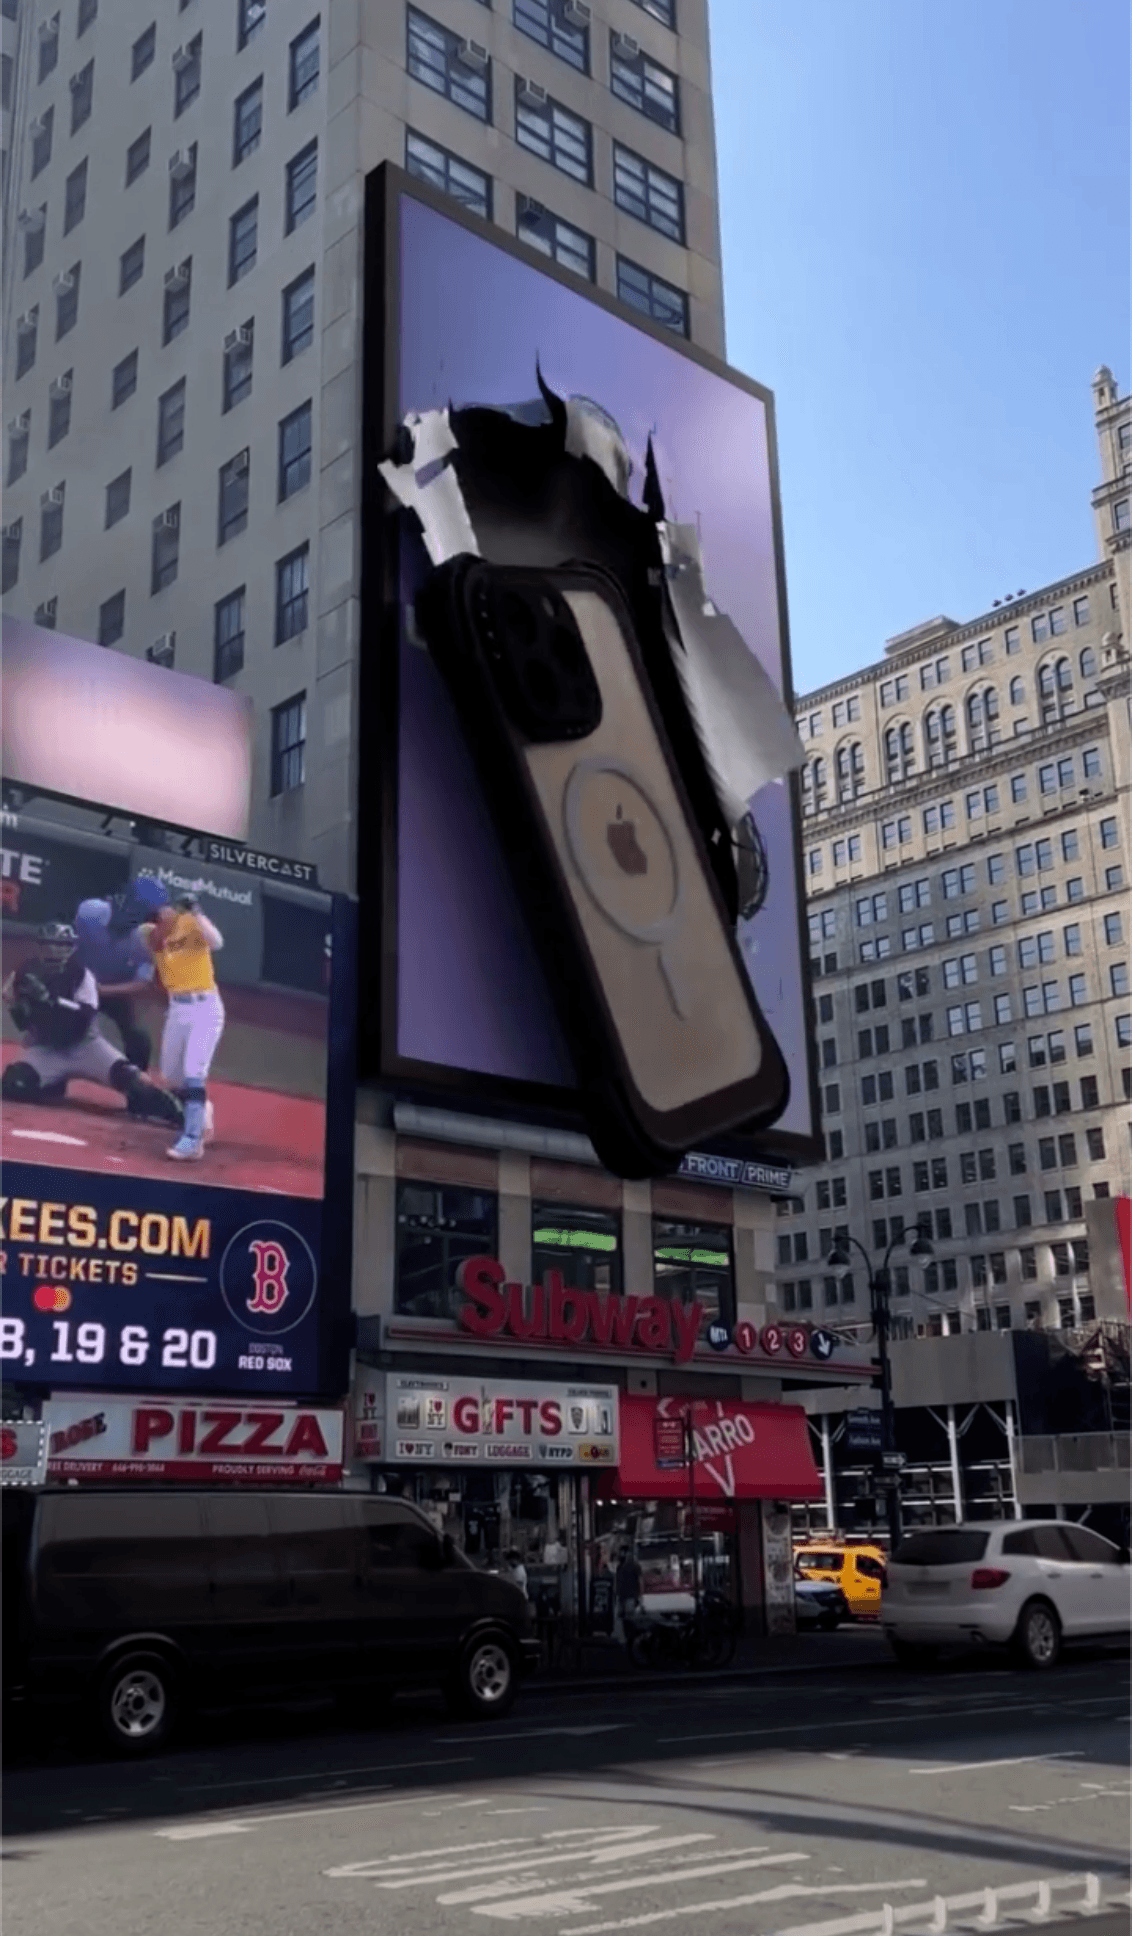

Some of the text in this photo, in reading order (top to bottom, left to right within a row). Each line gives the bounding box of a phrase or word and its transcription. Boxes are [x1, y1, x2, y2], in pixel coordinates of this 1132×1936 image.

[209, 843, 313, 880] SILVERCAST
[158, 867, 253, 905] MassMutual
[747, 1167, 788, 1186] PRIME
[1, 1199, 210, 1259] EES.COM
[18, 1252, 138, 1286] TICKETS
[456, 1256, 703, 1365] Subway
[51, 1321, 105, 1364] 19
[119, 1326, 150, 1366] &
[162, 1328, 217, 1369] 20
[742, 1327, 750, 1348] 1
[768, 1330, 780, 1350] 2
[793, 1332, 804, 1352] 3
[239, 1355, 292, 1372] RED SOX
[132, 1408, 330, 1458] PIZZA
[453, 1396, 563, 1436] GIFTS
[487, 1445, 531, 1457] LUGGAGE
[548, 1446, 573, 1458] NYPD
